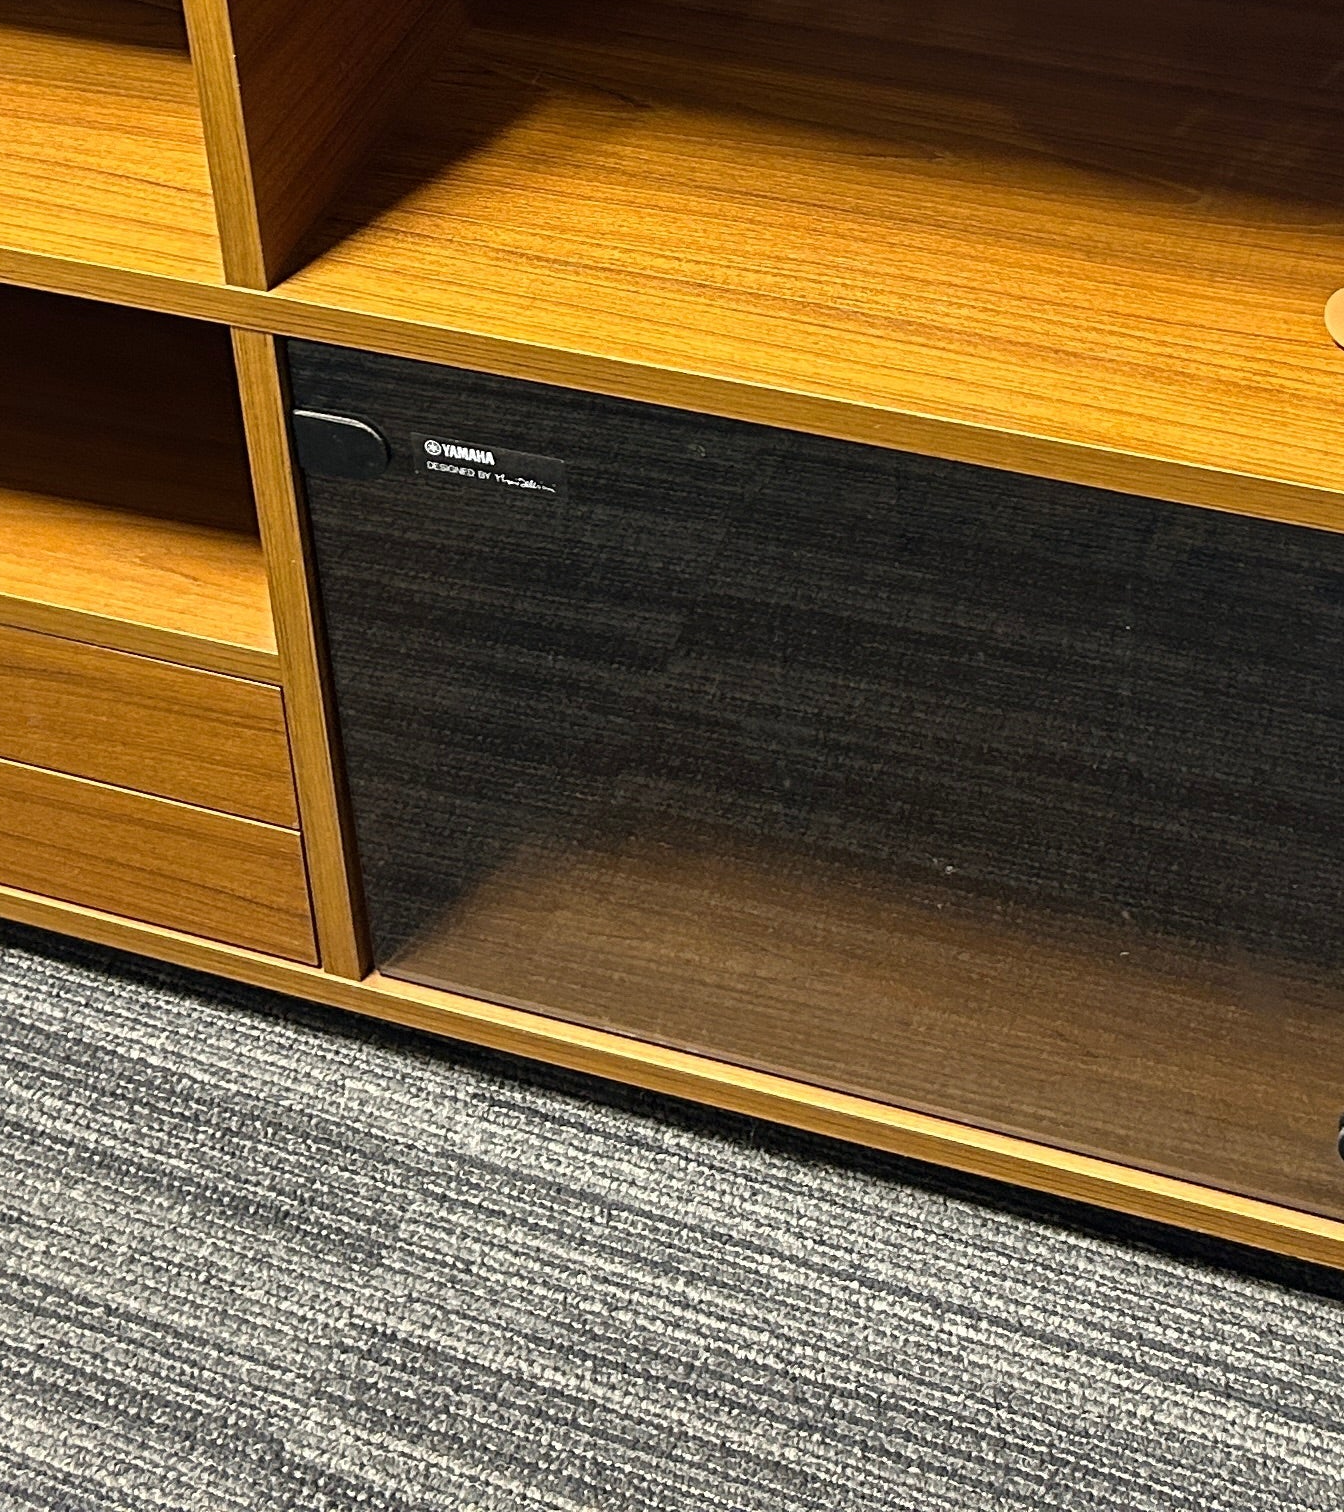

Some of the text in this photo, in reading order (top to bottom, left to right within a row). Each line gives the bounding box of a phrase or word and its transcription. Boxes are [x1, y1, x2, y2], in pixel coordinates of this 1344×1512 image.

[441, 443, 496, 466] YAMAHA
[426, 460, 492, 480] DESIGNED BY
